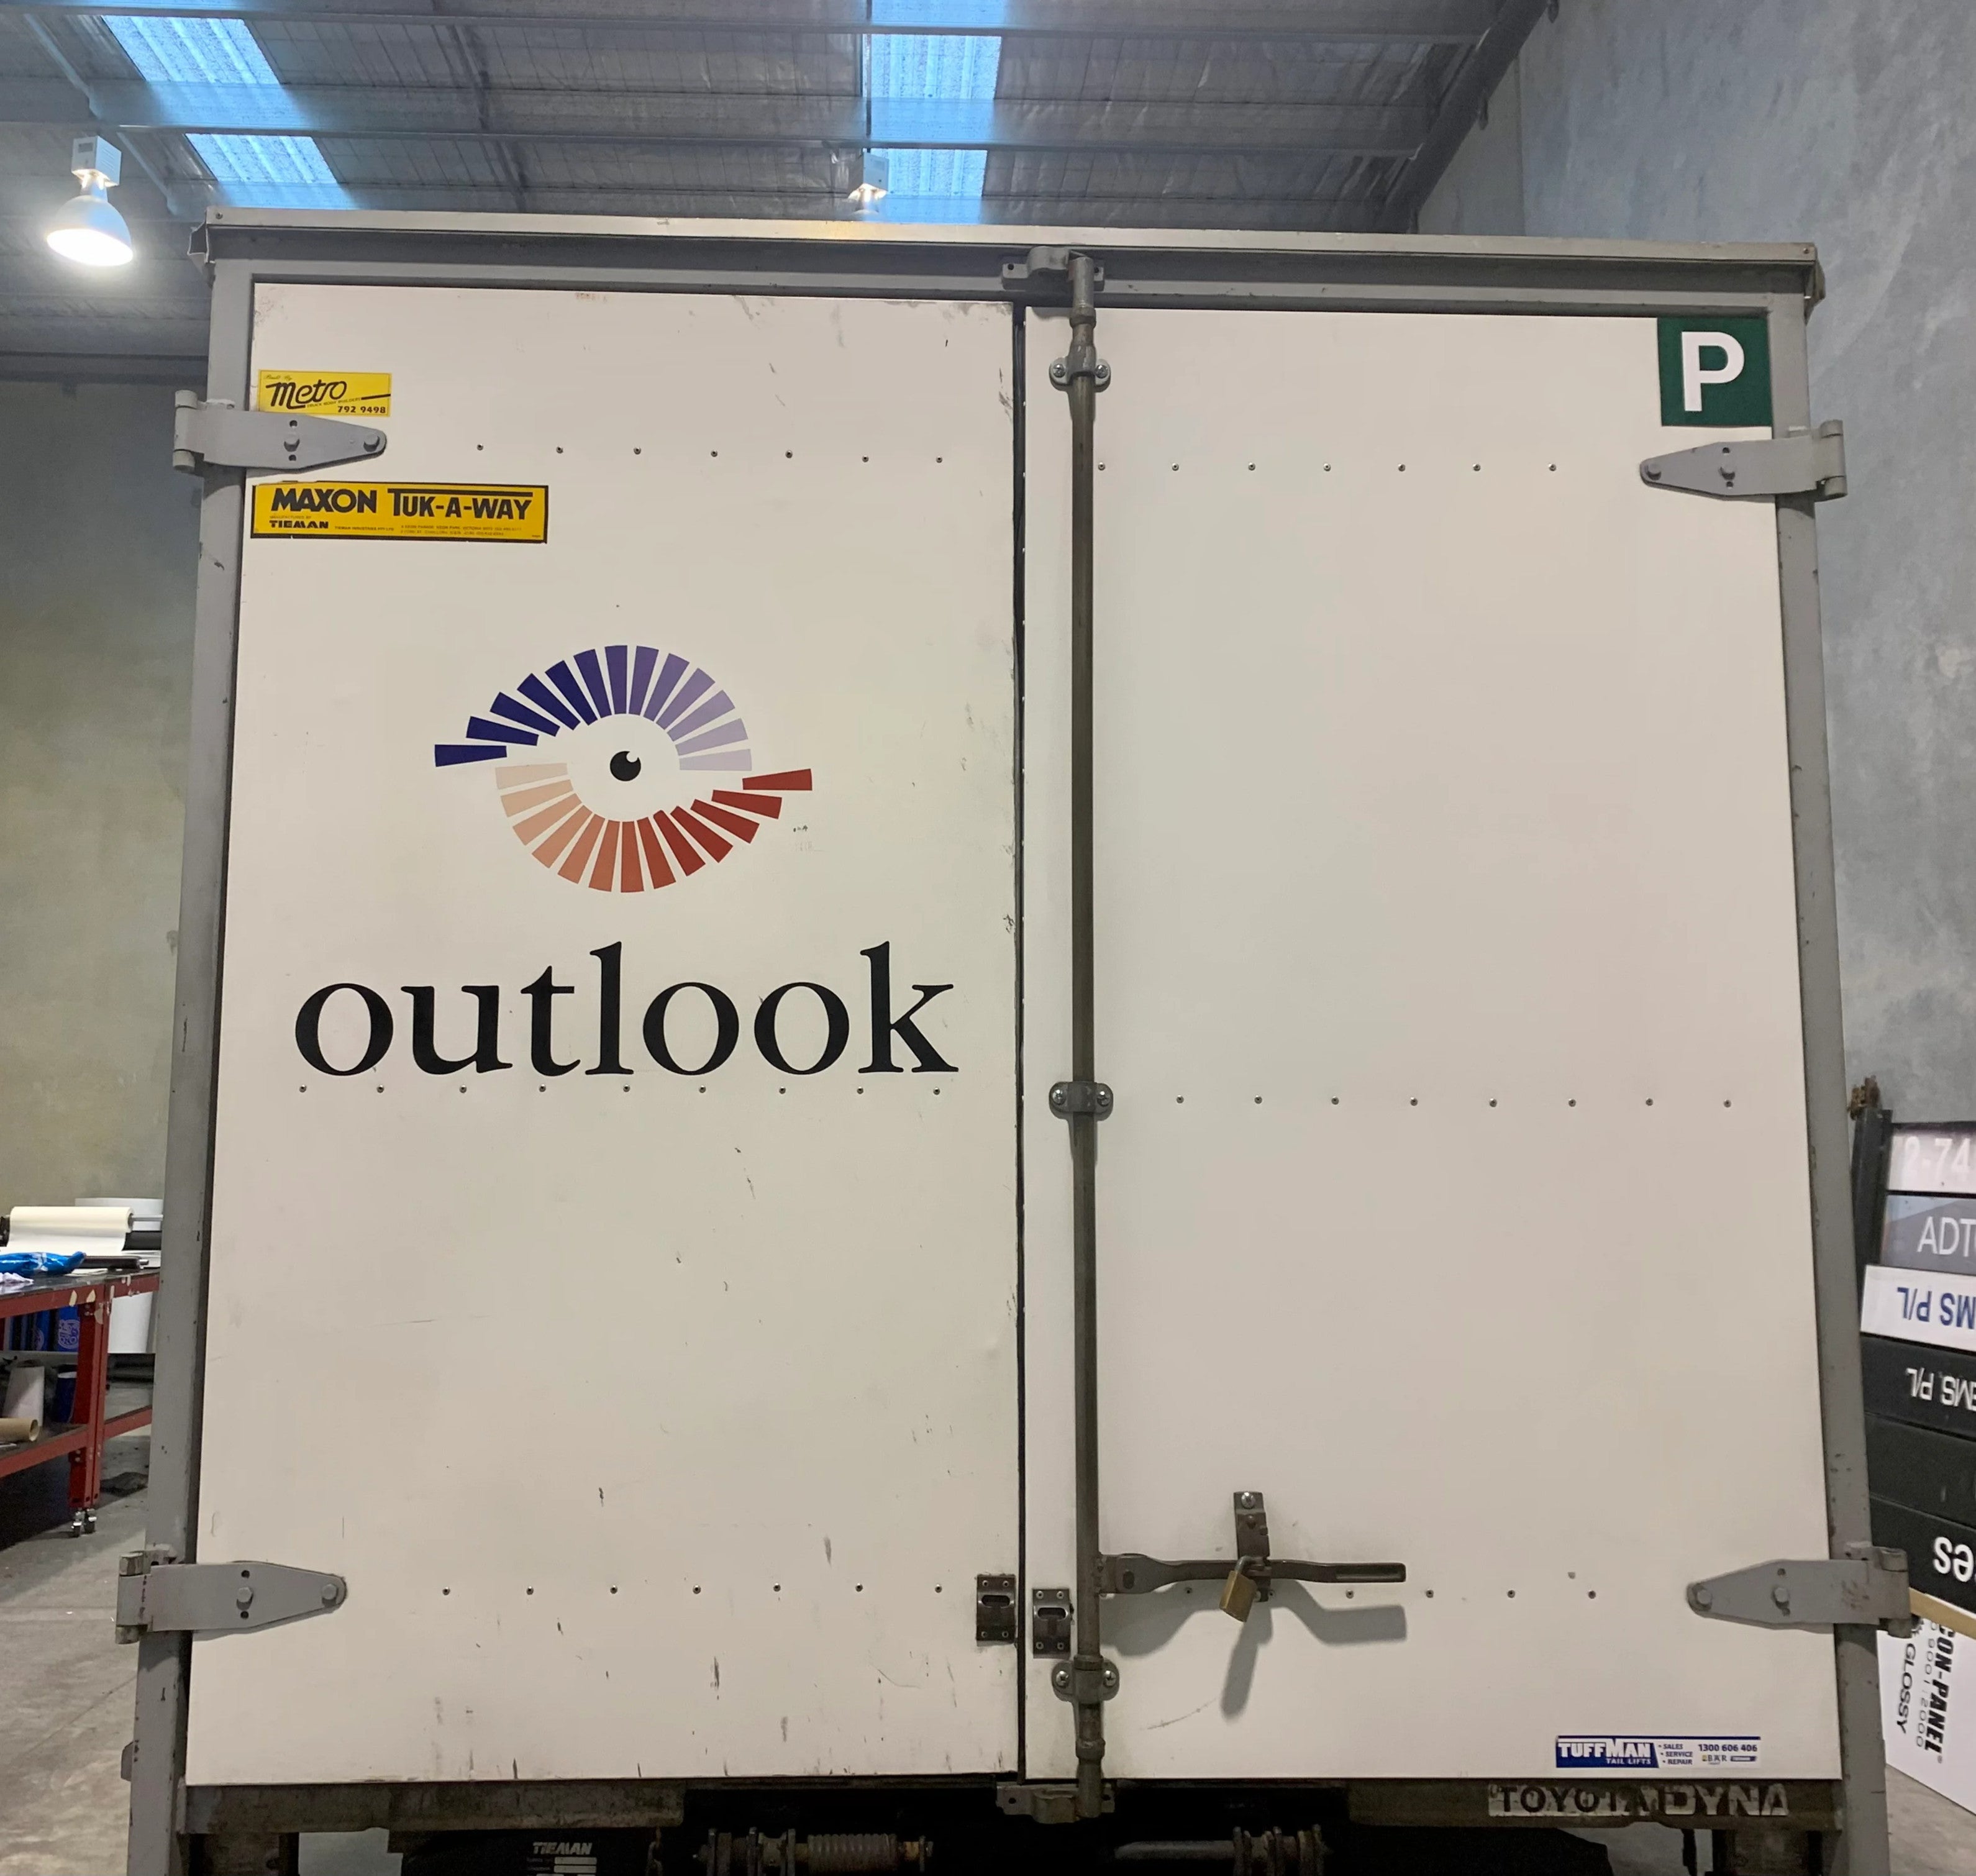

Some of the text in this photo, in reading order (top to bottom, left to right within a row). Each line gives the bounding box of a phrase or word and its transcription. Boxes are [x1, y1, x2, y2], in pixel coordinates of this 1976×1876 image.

[1682, 331, 1744, 411] P
[360, 406, 386, 414] 9498
[271, 488, 534, 520] MAXON TUK-A-WAY
[269, 520, 329, 529] TIEMAN
[294, 940, 959, 1077] outlook
[1917, 1216, 1976, 1258] ADT
[1897, 1287, 1932, 1323] P/L
[1905, 1367, 1934, 1401] P/L
[1896, 1642, 1916, 1734] GLOSSY
[1558, 1738, 1651, 1758] TUFFMAN
[1698, 1744, 1719, 1752] 1300
[1664, 1783, 1789, 1815] DYNA
